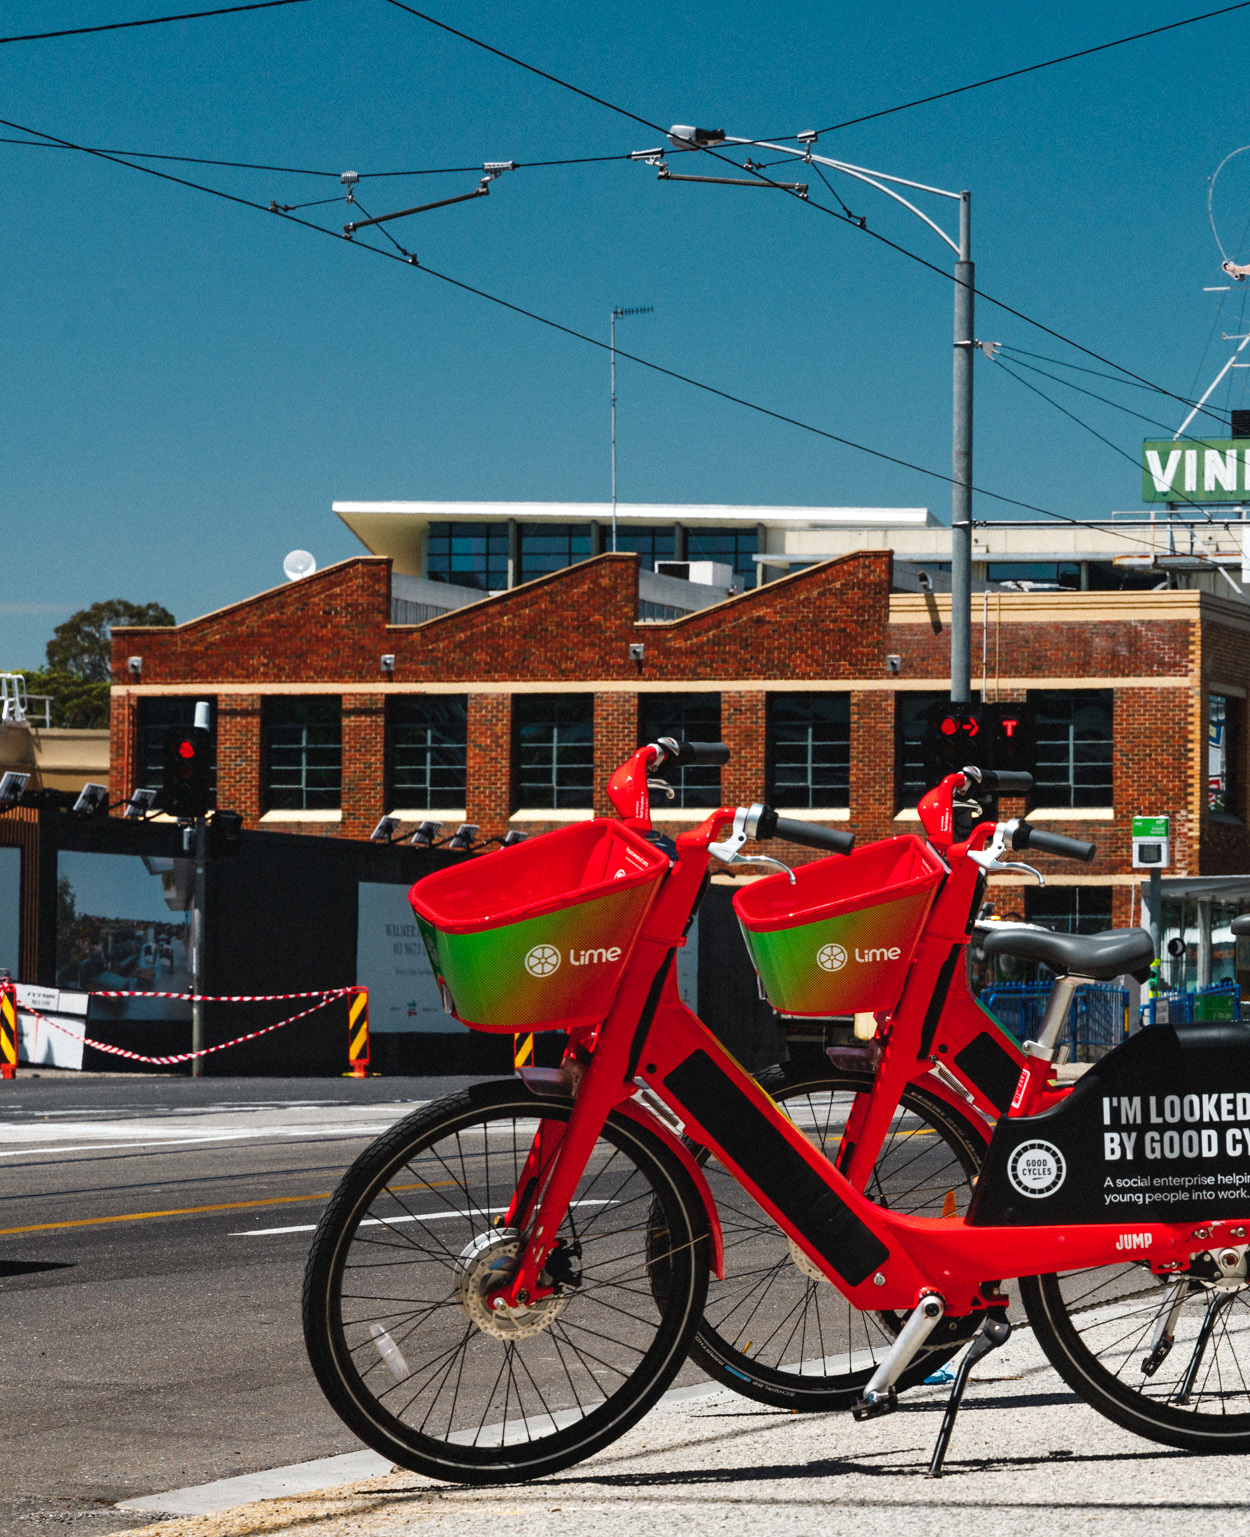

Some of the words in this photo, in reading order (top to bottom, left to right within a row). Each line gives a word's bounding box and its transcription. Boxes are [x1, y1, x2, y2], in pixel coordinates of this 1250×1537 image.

[570, 946, 621, 966] Lime
[856, 947, 901, 963] Lime
[1103, 1096, 1141, 1125] I'M
[1103, 1132, 1137, 1160] BY
[1145, 1128, 1218, 1159] GOOD
[1022, 1167, 1052, 1176] CYCLES
[1026, 1159, 1048, 1167] GOOD
[1104, 1176, 1114, 1187] A
[1116, 1175, 1150, 1187] social
[1153, 1174, 1215, 1187] enterprise
[1104, 1193, 1143, 1205] young
[1145, 1190, 1189, 1204] people
[1192, 1188, 1215, 1200] into
[1217, 1187, 1250, 1200] work.
[1116, 1232, 1153, 1250] JUMP
[694, 1335, 725, 1366] MARATHO
[751, 1381, 796, 1397] SCHWALBE
